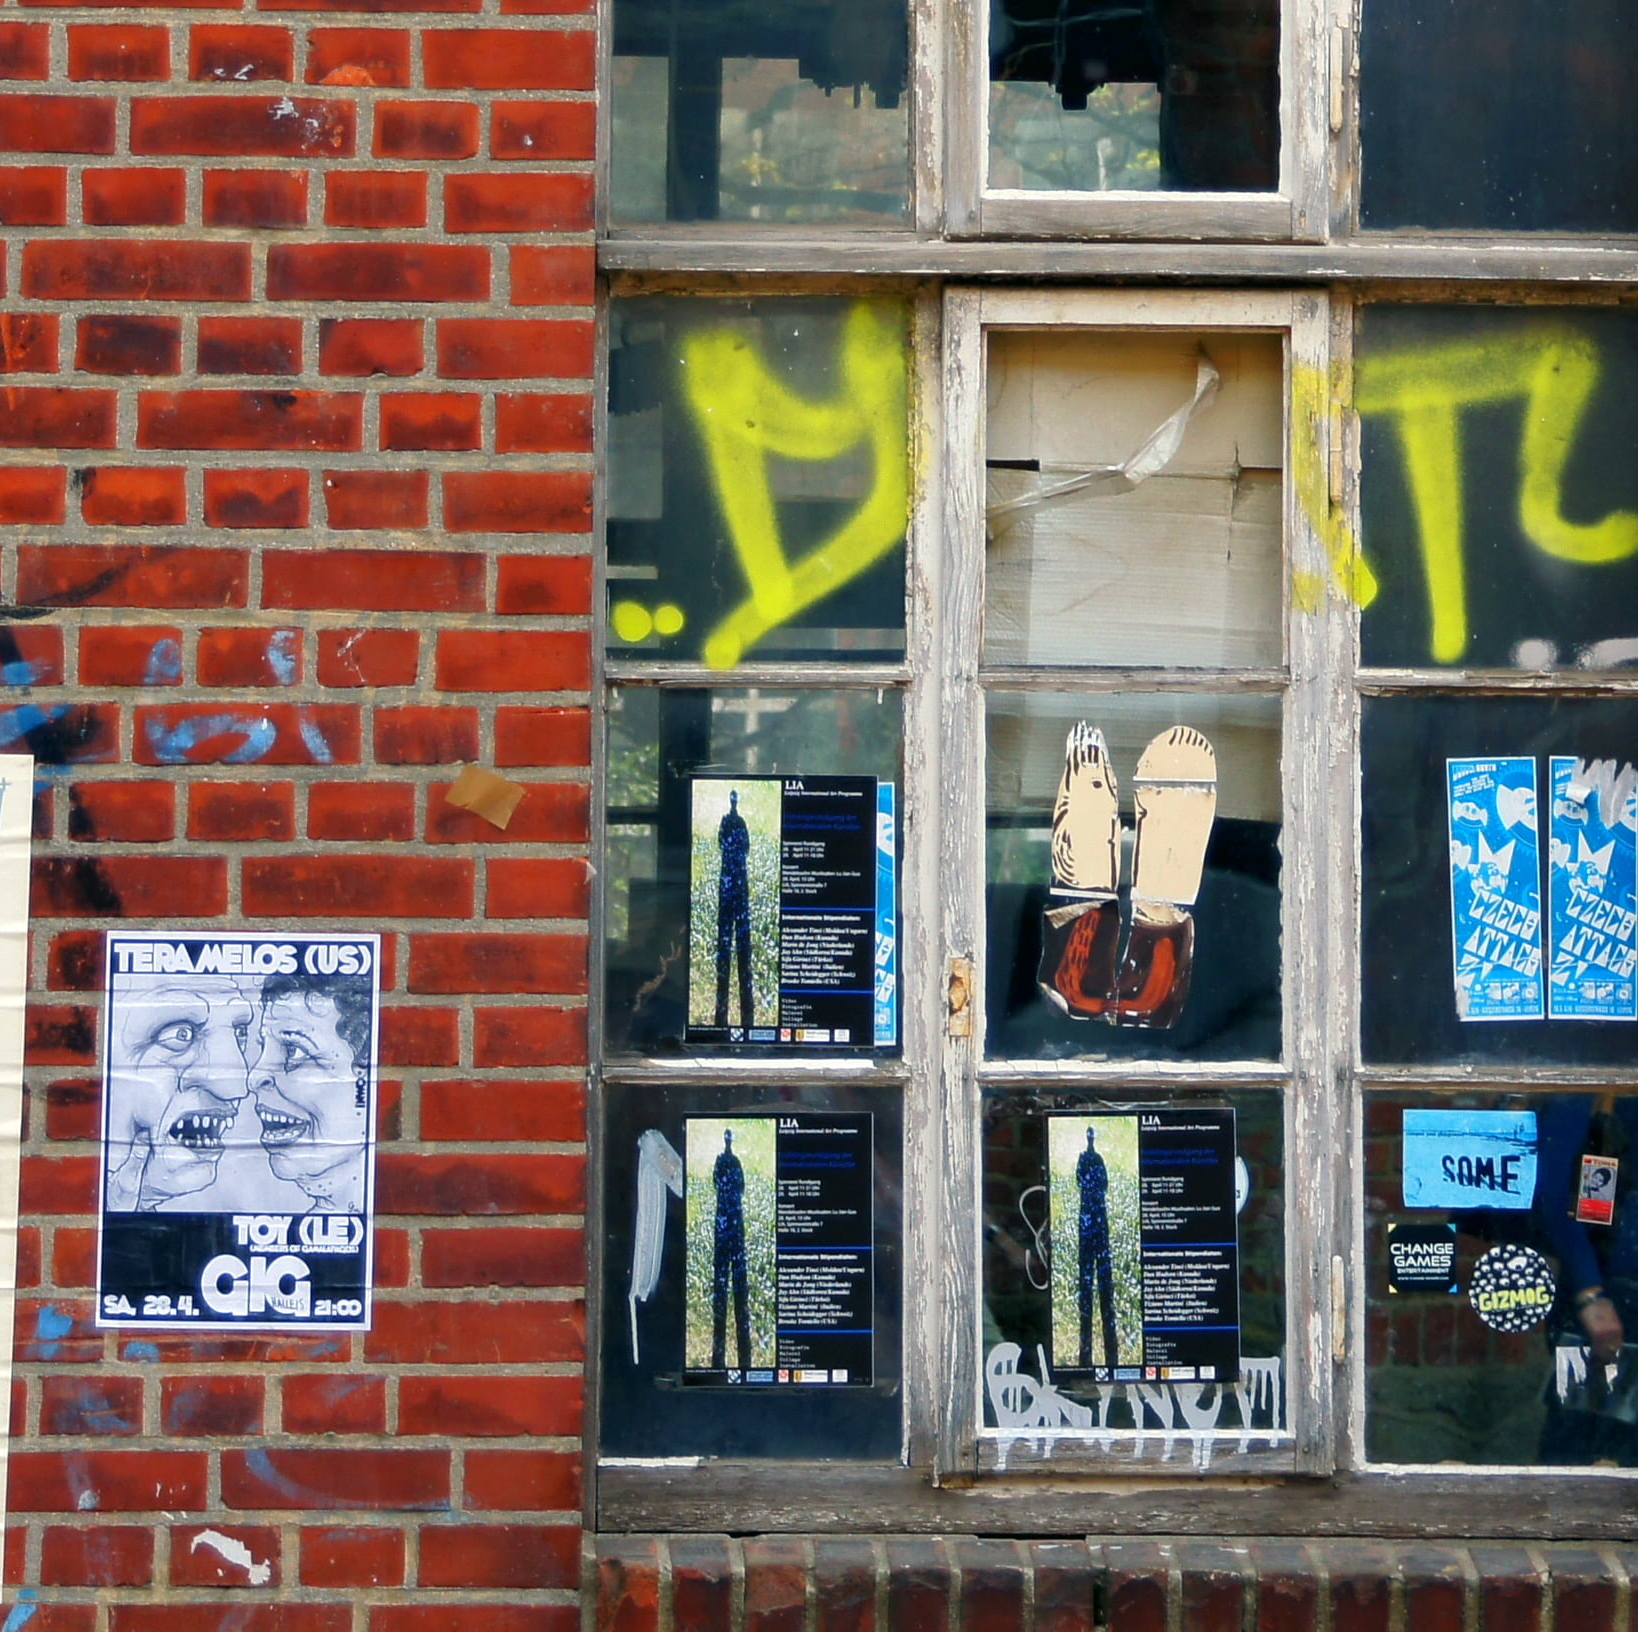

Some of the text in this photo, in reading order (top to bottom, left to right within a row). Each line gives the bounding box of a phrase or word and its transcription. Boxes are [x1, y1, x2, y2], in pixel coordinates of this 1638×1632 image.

[785, 780, 804, 790] LIA
[303, 944, 372, 975] (US)
[779, 1118, 799, 1128] LIA
[1142, 1116, 1160, 1125] LIA
[1442, 1154, 1521, 1193] SOME
[232, 1215, 364, 1246] TOY (LE)
[1390, 1243, 1454, 1255] CHANGE
[1394, 1255, 1452, 1268] GAMES
[201, 1254, 311, 1317] GIG
[1478, 1285, 1550, 1312] GIZMOG
[315, 1299, 363, 1316] 21:00
